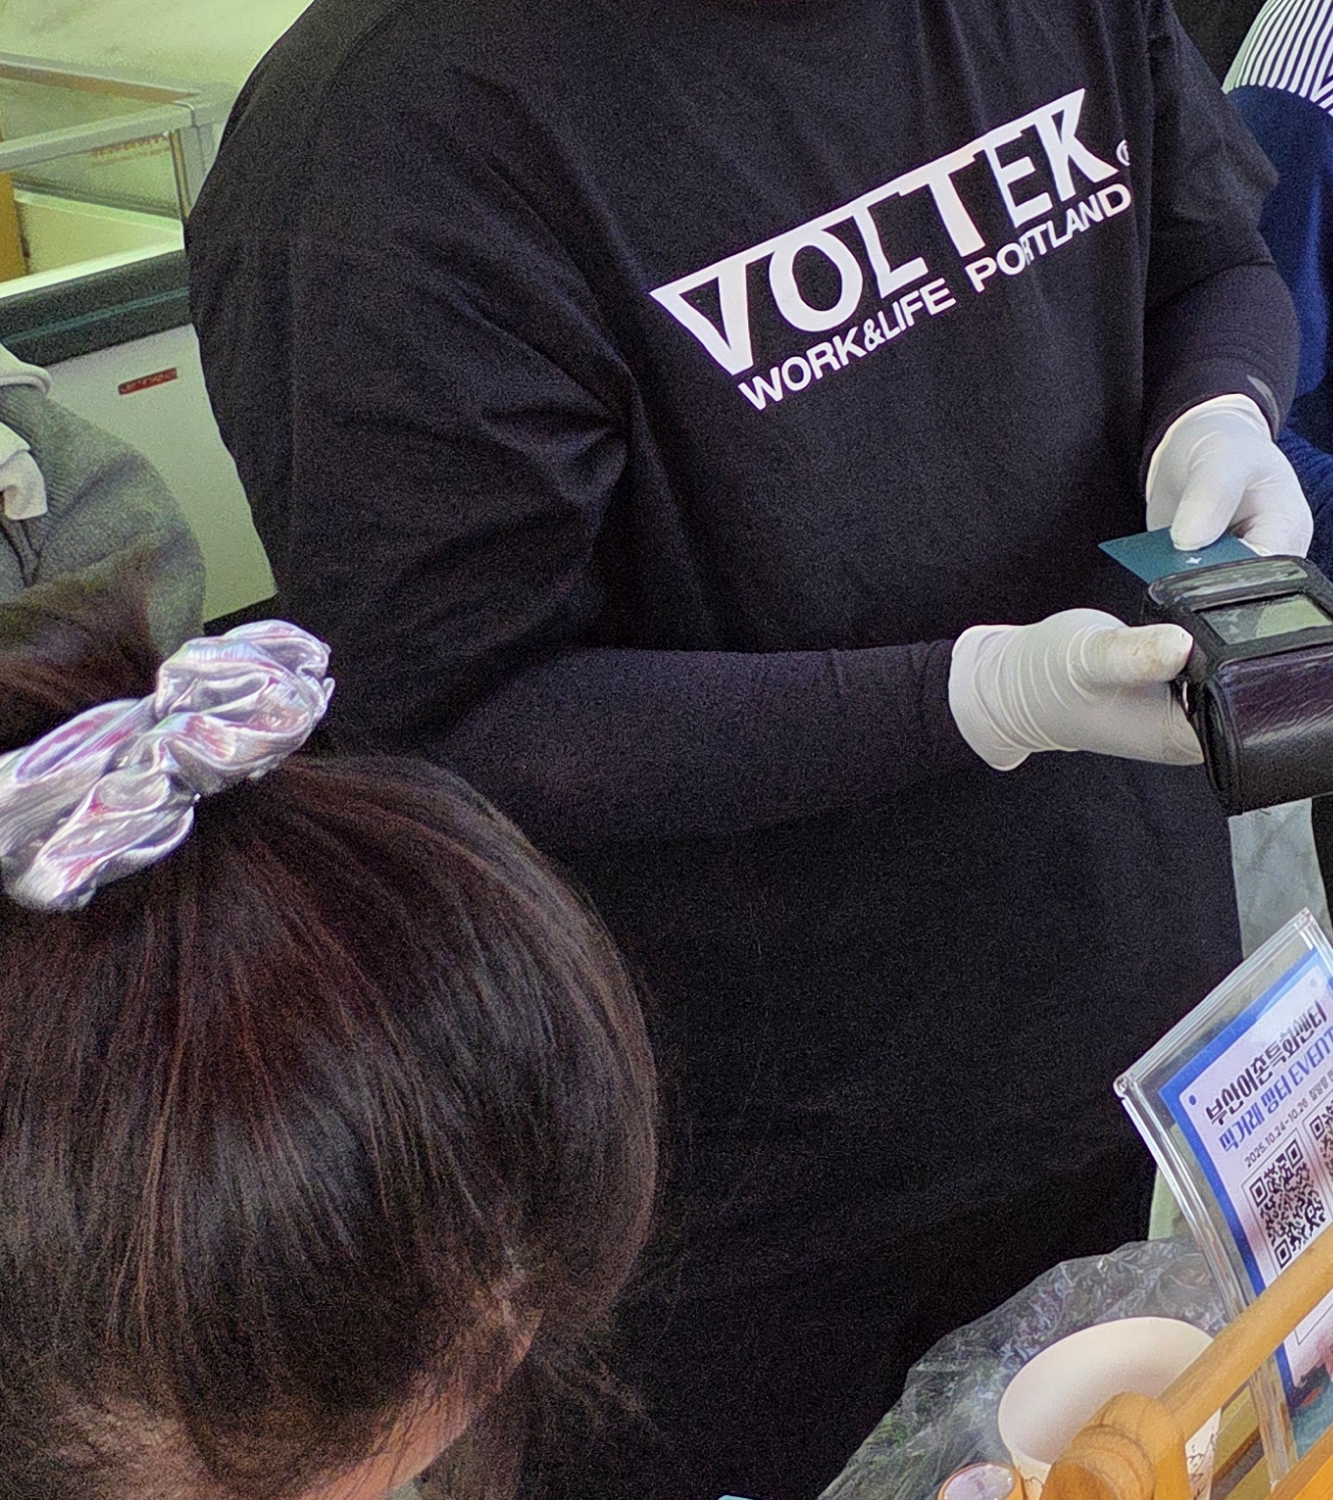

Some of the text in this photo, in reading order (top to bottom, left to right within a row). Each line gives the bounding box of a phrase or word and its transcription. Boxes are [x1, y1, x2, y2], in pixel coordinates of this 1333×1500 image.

[648, 88, 1119, 376] VOLTEK
[738, 183, 1131, 410] WORK&LIFE PORTLAND
